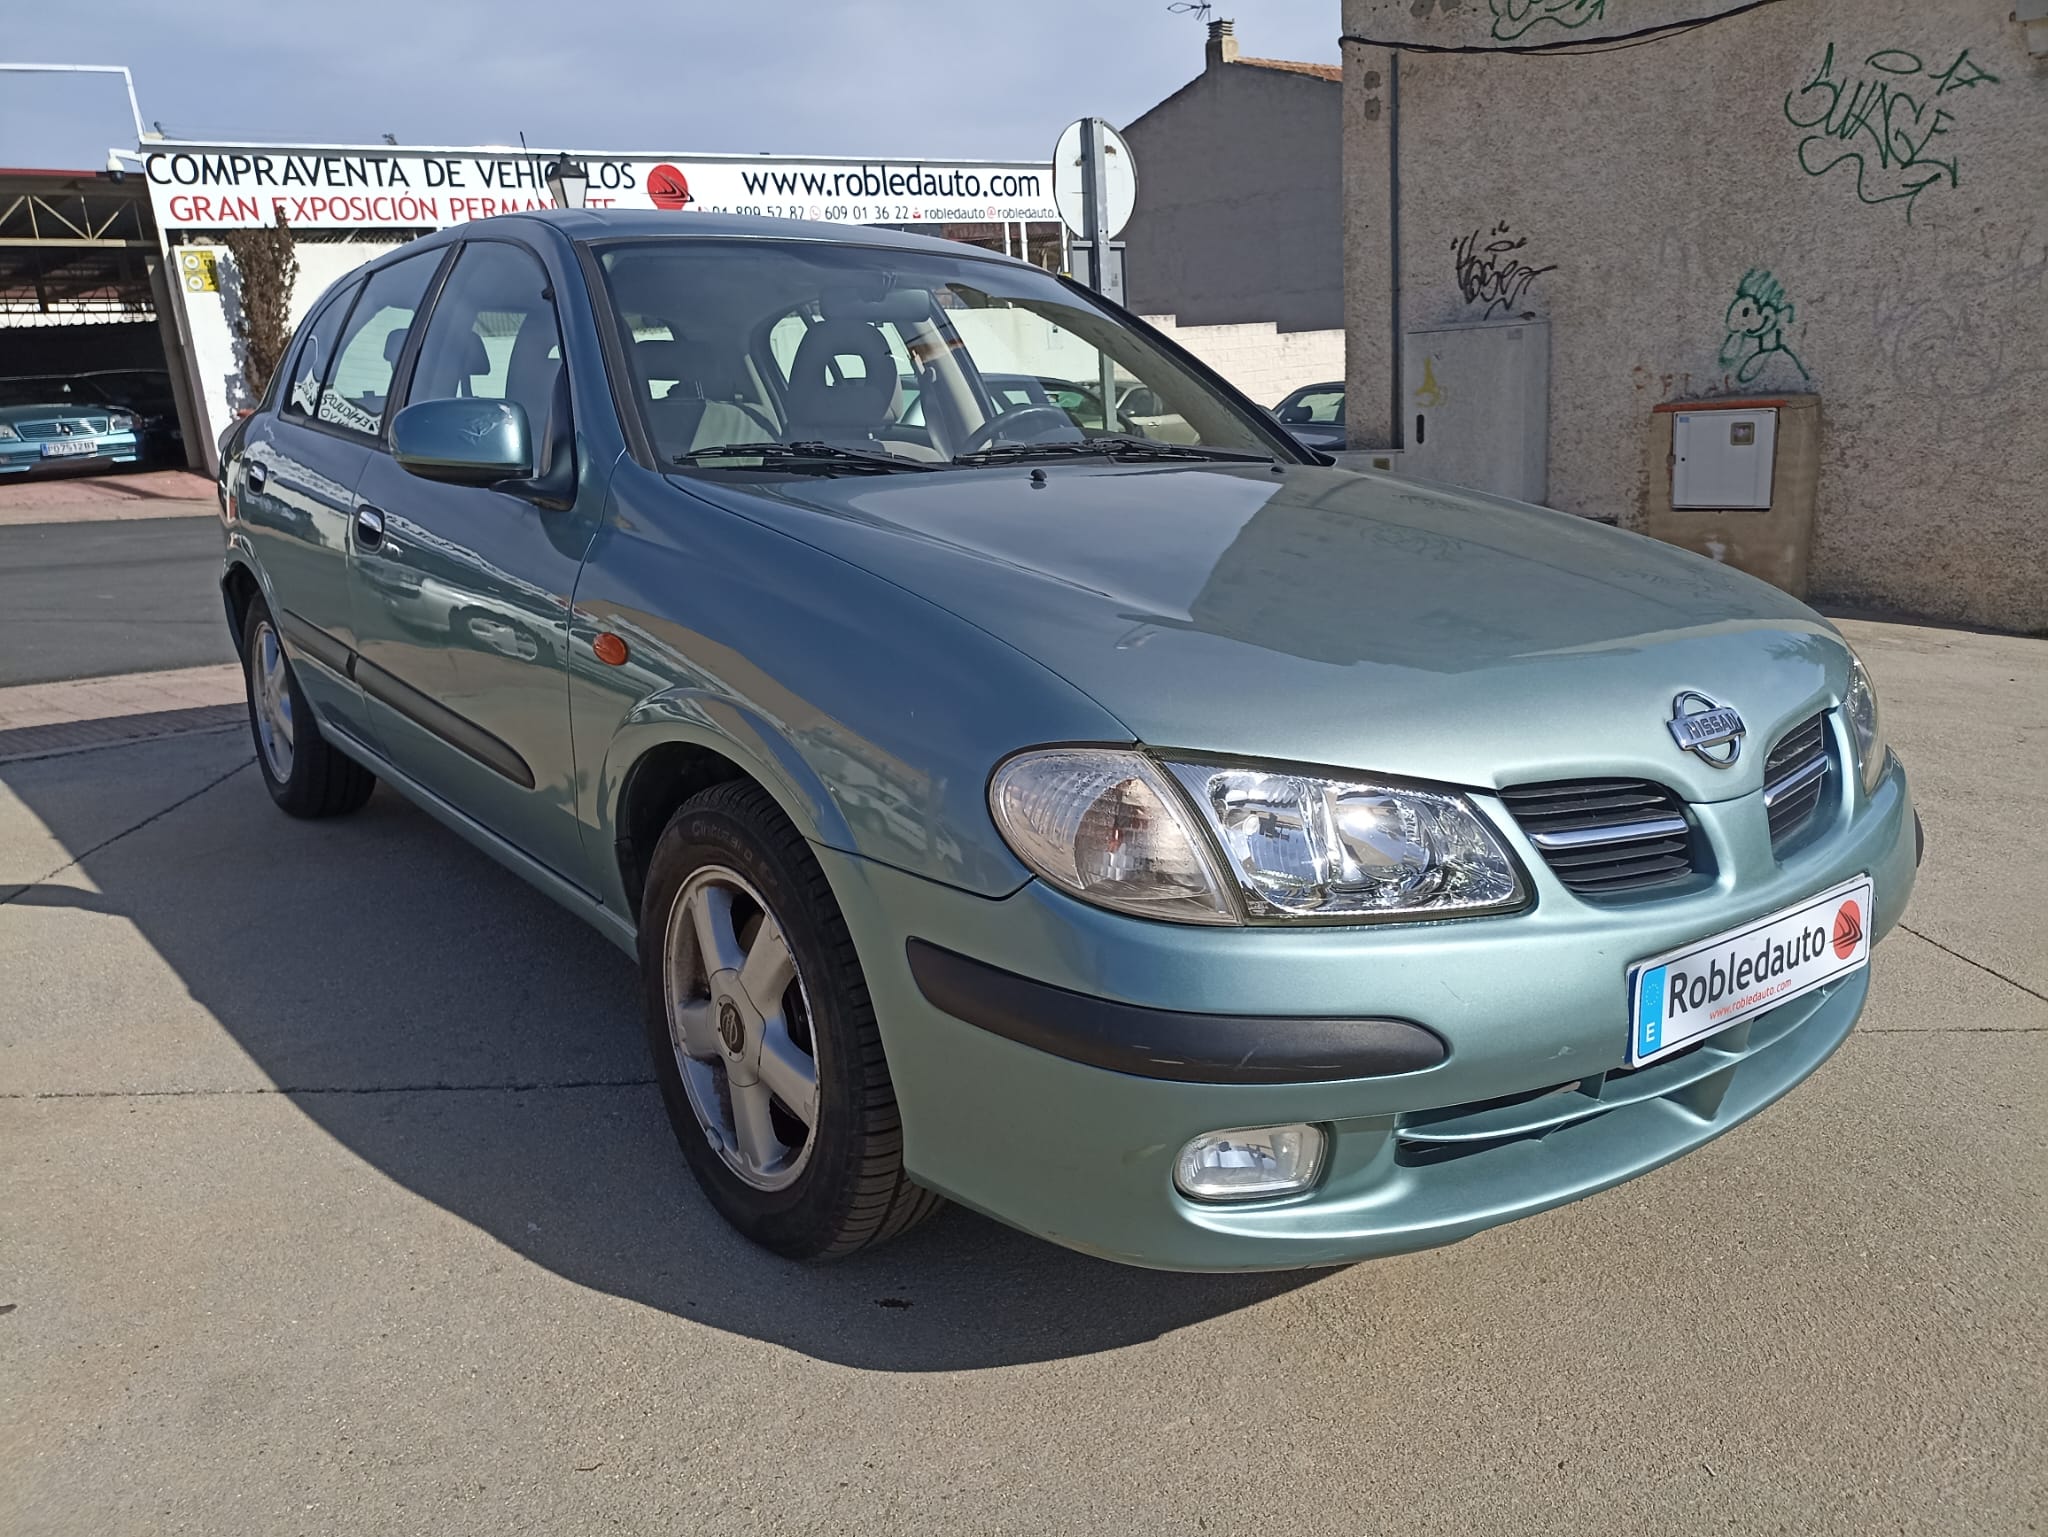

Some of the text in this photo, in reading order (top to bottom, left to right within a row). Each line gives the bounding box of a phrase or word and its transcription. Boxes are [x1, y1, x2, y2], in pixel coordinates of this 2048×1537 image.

[146, 153, 635, 189] COMPRAVENTA DE VEHÍCLOS
[741, 165, 1040, 197] www.robledauto.com
[169, 196, 259, 221] GRAN
[272, 191, 438, 221] EXPOSICIÓN
[825, 205, 848, 220] 609
[853, 205, 867, 220] 01
[874, 205, 890, 220] 36
[894, 205, 909, 220] 22
[1683, 712, 1740, 740] NISSAN
[1668, 926, 1826, 1018] Robledauto
[1709, 978, 1792, 1020] www.robledauto.com
[1646, 1022, 1656, 1043] E
